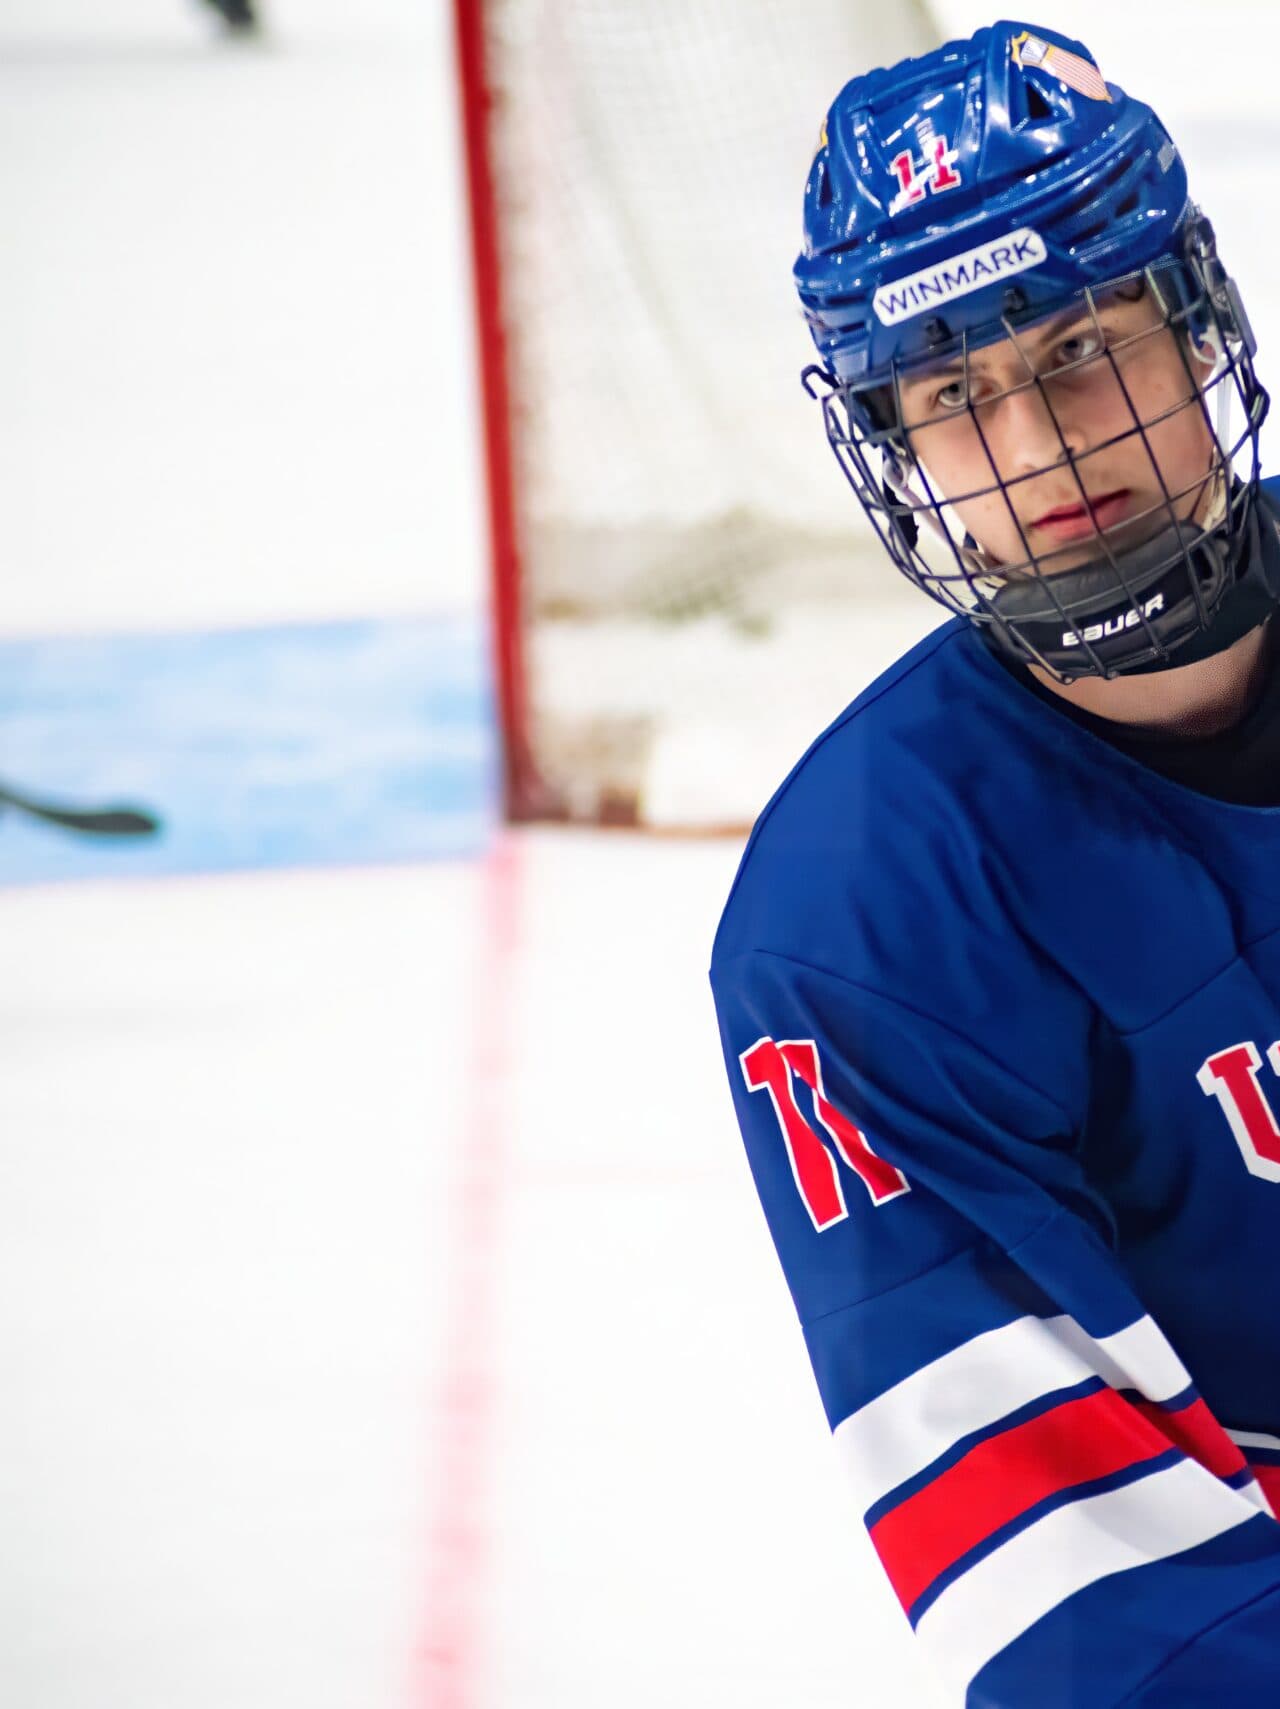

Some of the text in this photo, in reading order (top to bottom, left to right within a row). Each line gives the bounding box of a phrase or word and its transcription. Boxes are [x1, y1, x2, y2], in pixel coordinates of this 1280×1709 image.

[889, 135, 961, 205] 11
[879, 236, 1038, 315] WINMARK
[1062, 592, 1164, 647] BAUER
[739, 1036, 912, 1233] 11
